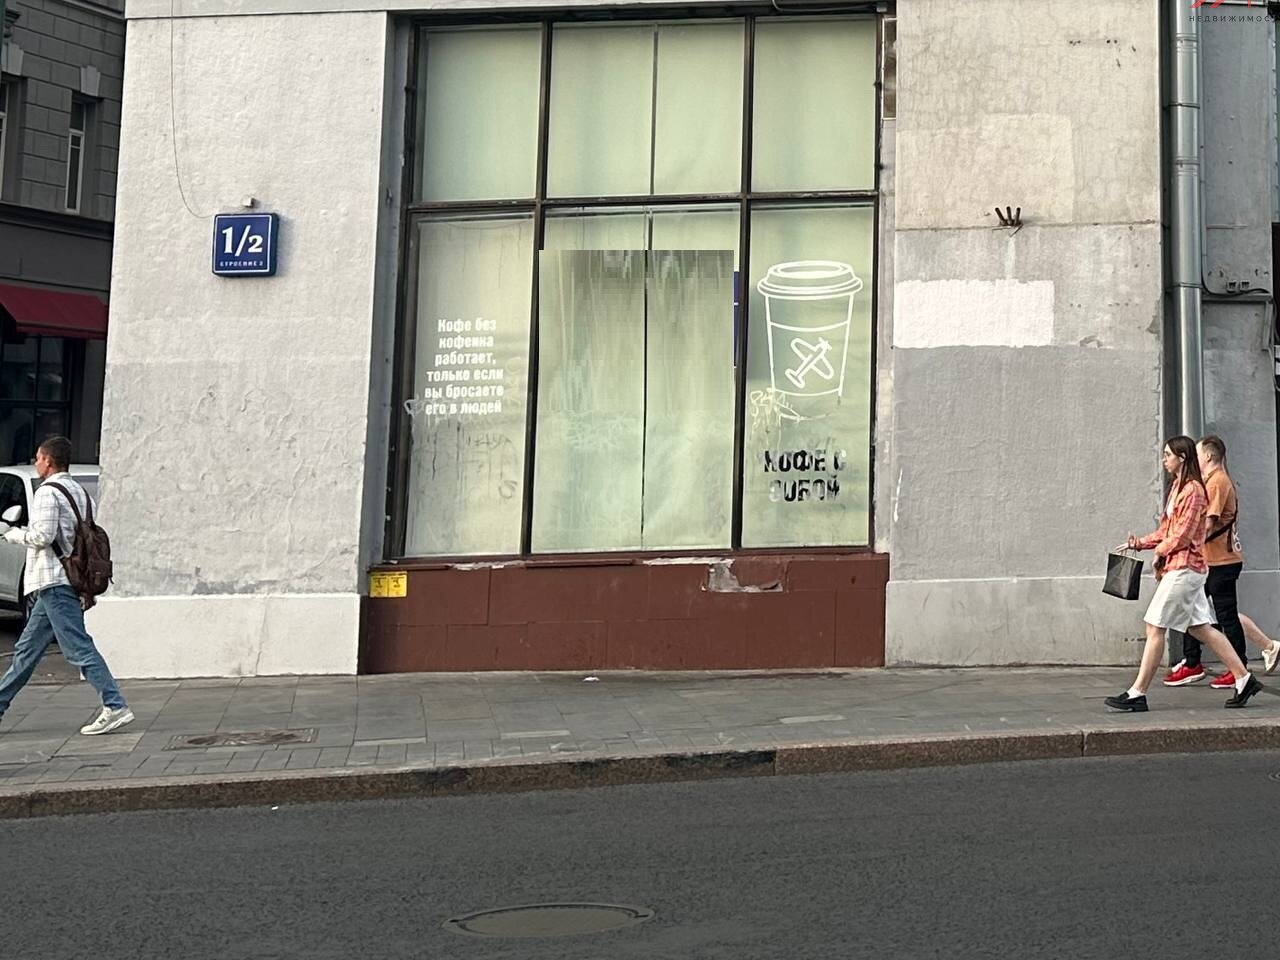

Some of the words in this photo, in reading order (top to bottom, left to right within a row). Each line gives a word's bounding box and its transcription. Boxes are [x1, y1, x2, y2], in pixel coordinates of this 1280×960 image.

[222, 225, 263, 257] 1/2
[438, 319, 472, 333] Кофе
[475, 318, 497, 331] без
[439, 335, 495, 350] кофеина
[435, 351, 497, 367] работает,
[426, 370, 471, 382] только
[473, 368, 504, 380] если
[425, 387, 443, 399] вы
[446, 384, 504, 399] бросаете
[425, 403, 447, 415] его
[450, 403, 457, 414] в
[460, 400, 502, 415] людей
